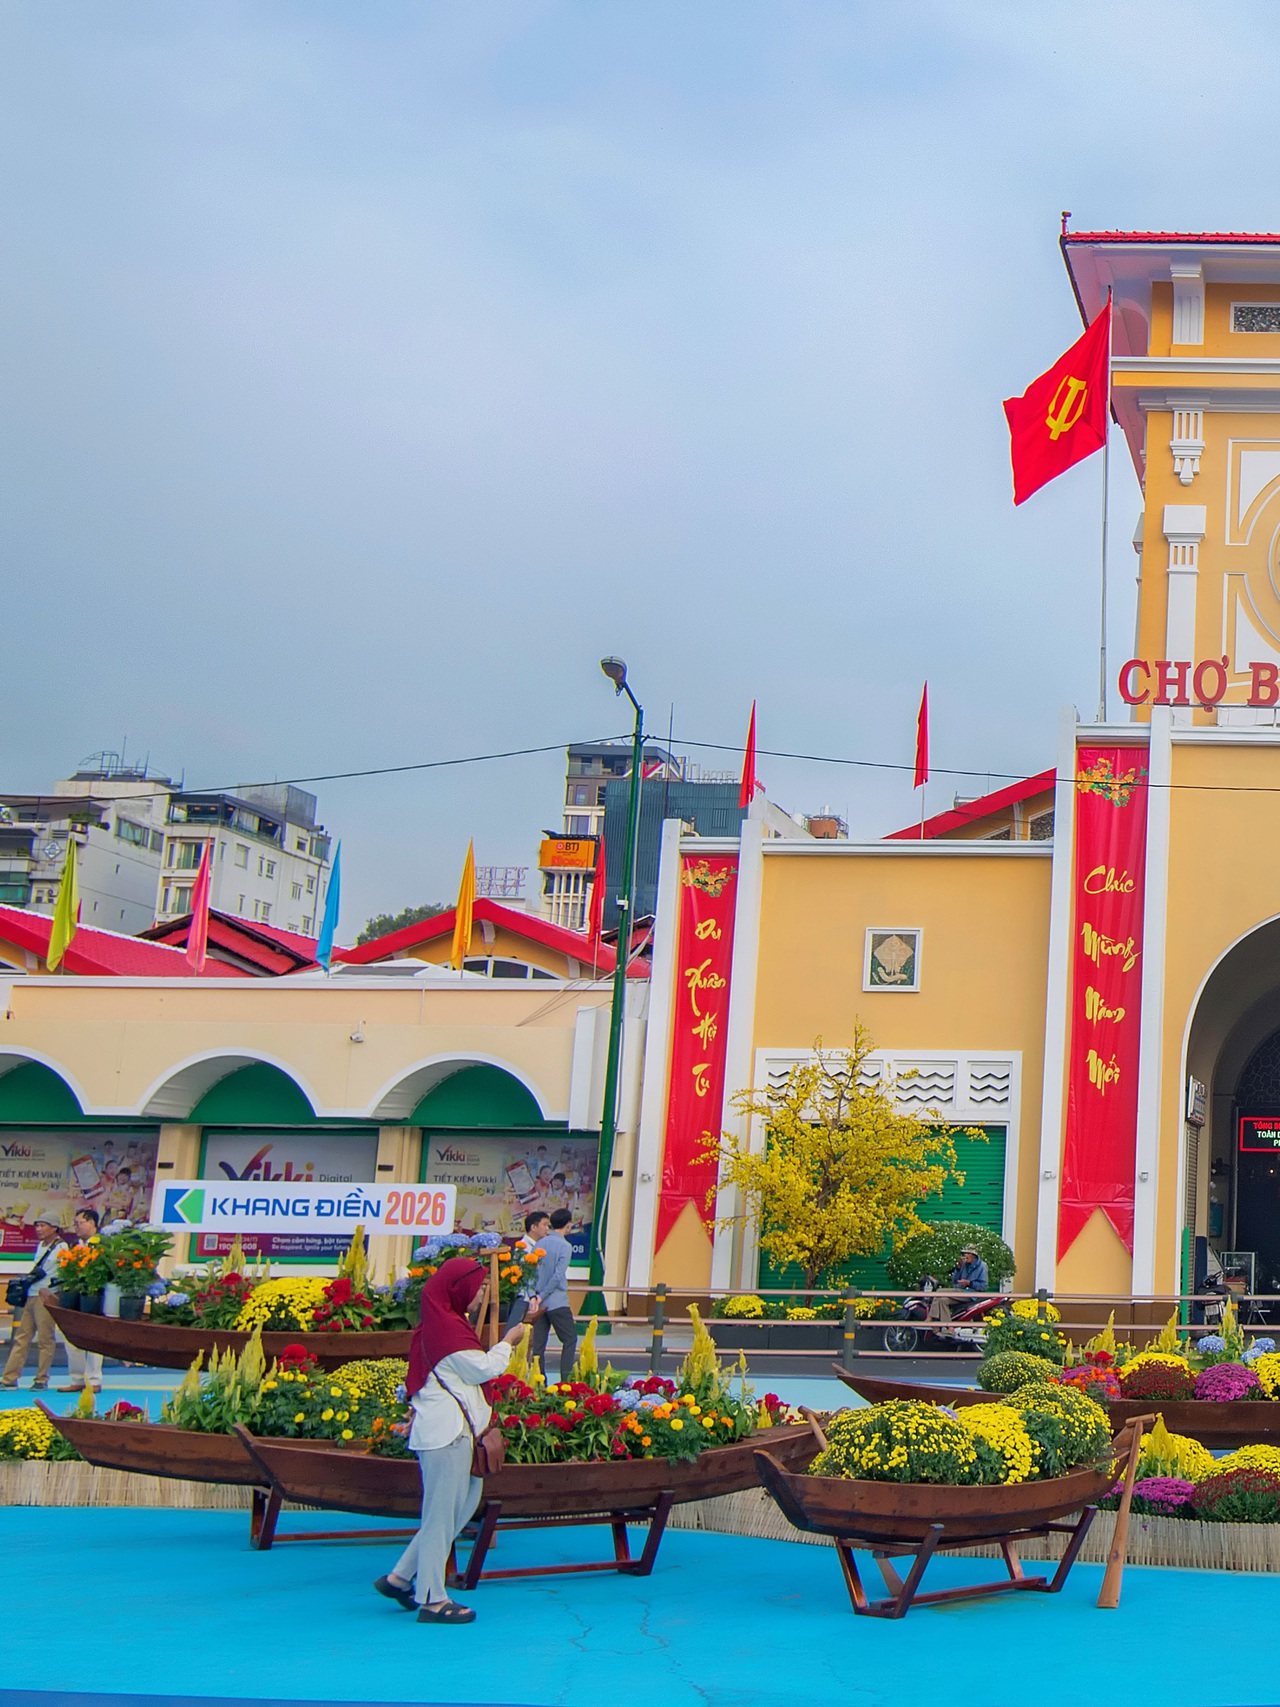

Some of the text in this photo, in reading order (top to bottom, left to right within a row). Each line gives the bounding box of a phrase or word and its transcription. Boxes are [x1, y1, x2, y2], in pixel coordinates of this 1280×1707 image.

[1118, 655, 1230, 713] CHỢ
[1084, 865, 1137, 895] Chúc
[695, 918, 722, 940] Du
[1080, 922, 1143, 973] Mừng
[684, 958, 727, 1017] Xuân
[1085, 986, 1126, 1029] Năm
[692, 1012, 718, 1050] Hội
[1085, 1049, 1121, 1097] Mới
[436, 1144, 466, 1161] Vikki
[211, 1187, 447, 1226] KHANG ĐIỀN 2026
